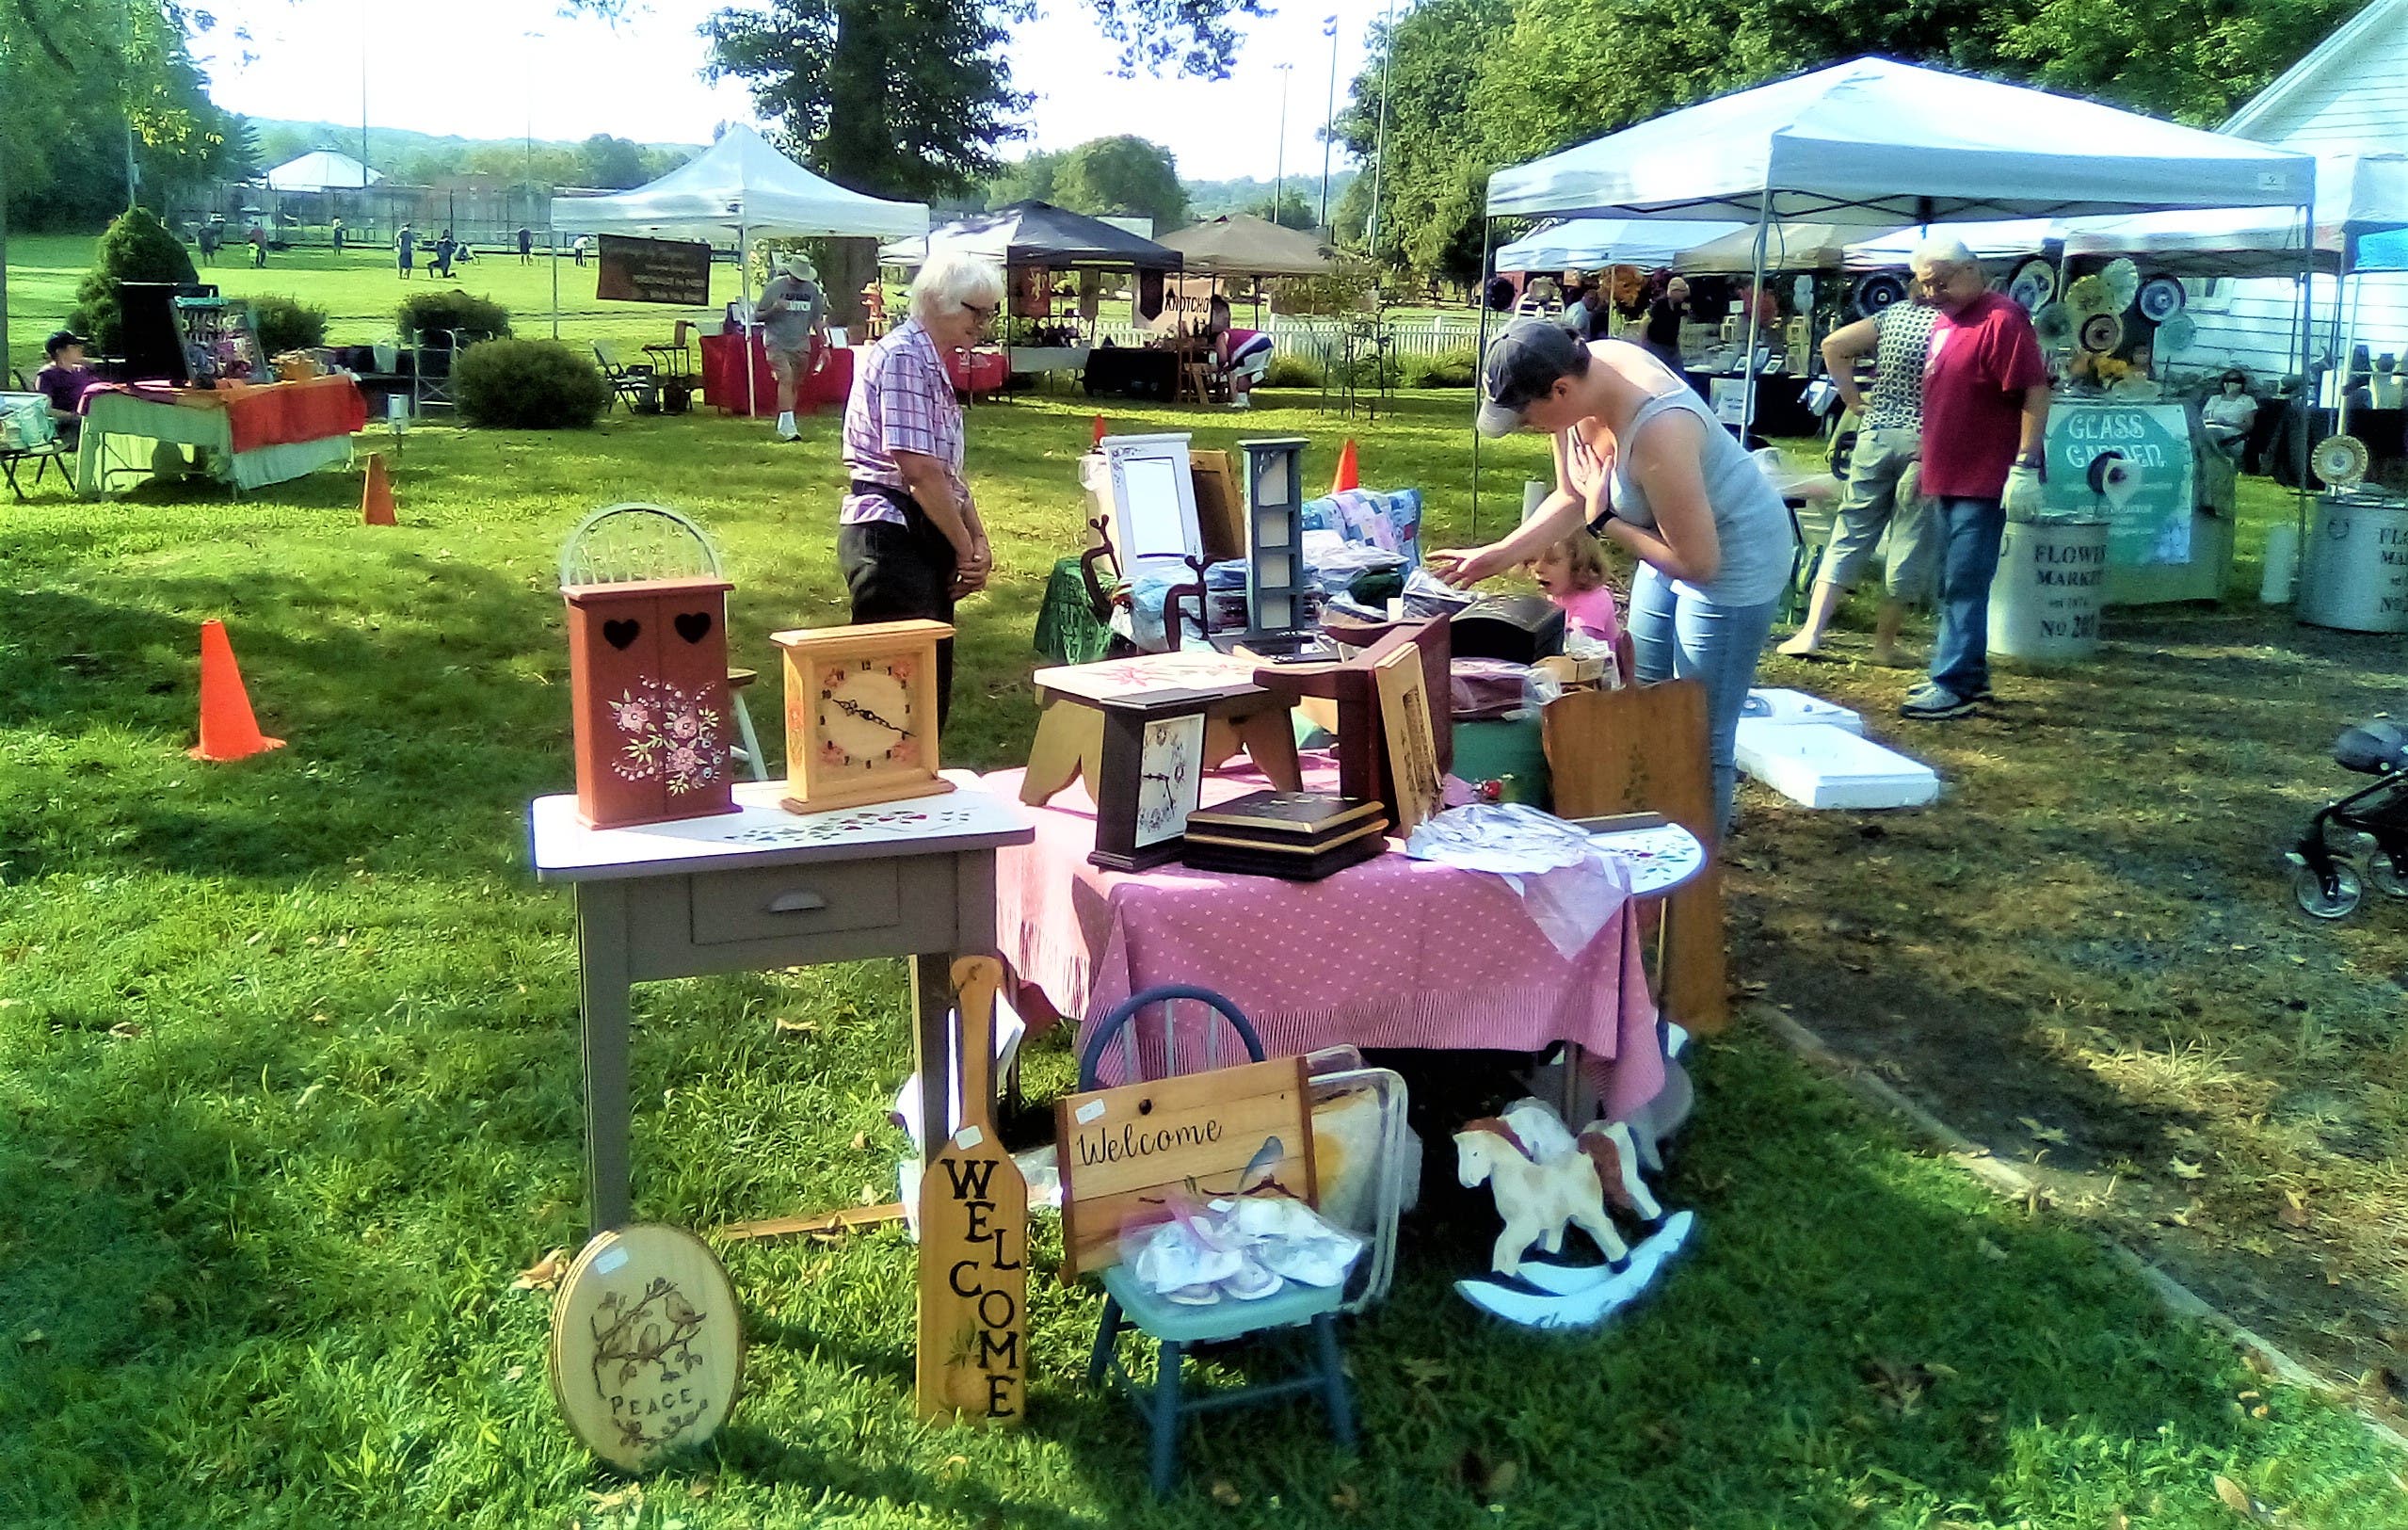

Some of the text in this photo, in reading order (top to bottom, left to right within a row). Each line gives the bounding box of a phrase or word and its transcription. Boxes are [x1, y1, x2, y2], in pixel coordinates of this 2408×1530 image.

[2069, 413, 2145, 440] GLASS
[1077, 1119, 1223, 1167] Welcome
[941, 1158, 1020, 1417] WELCOME
[611, 1389, 693, 1415] PEACE
